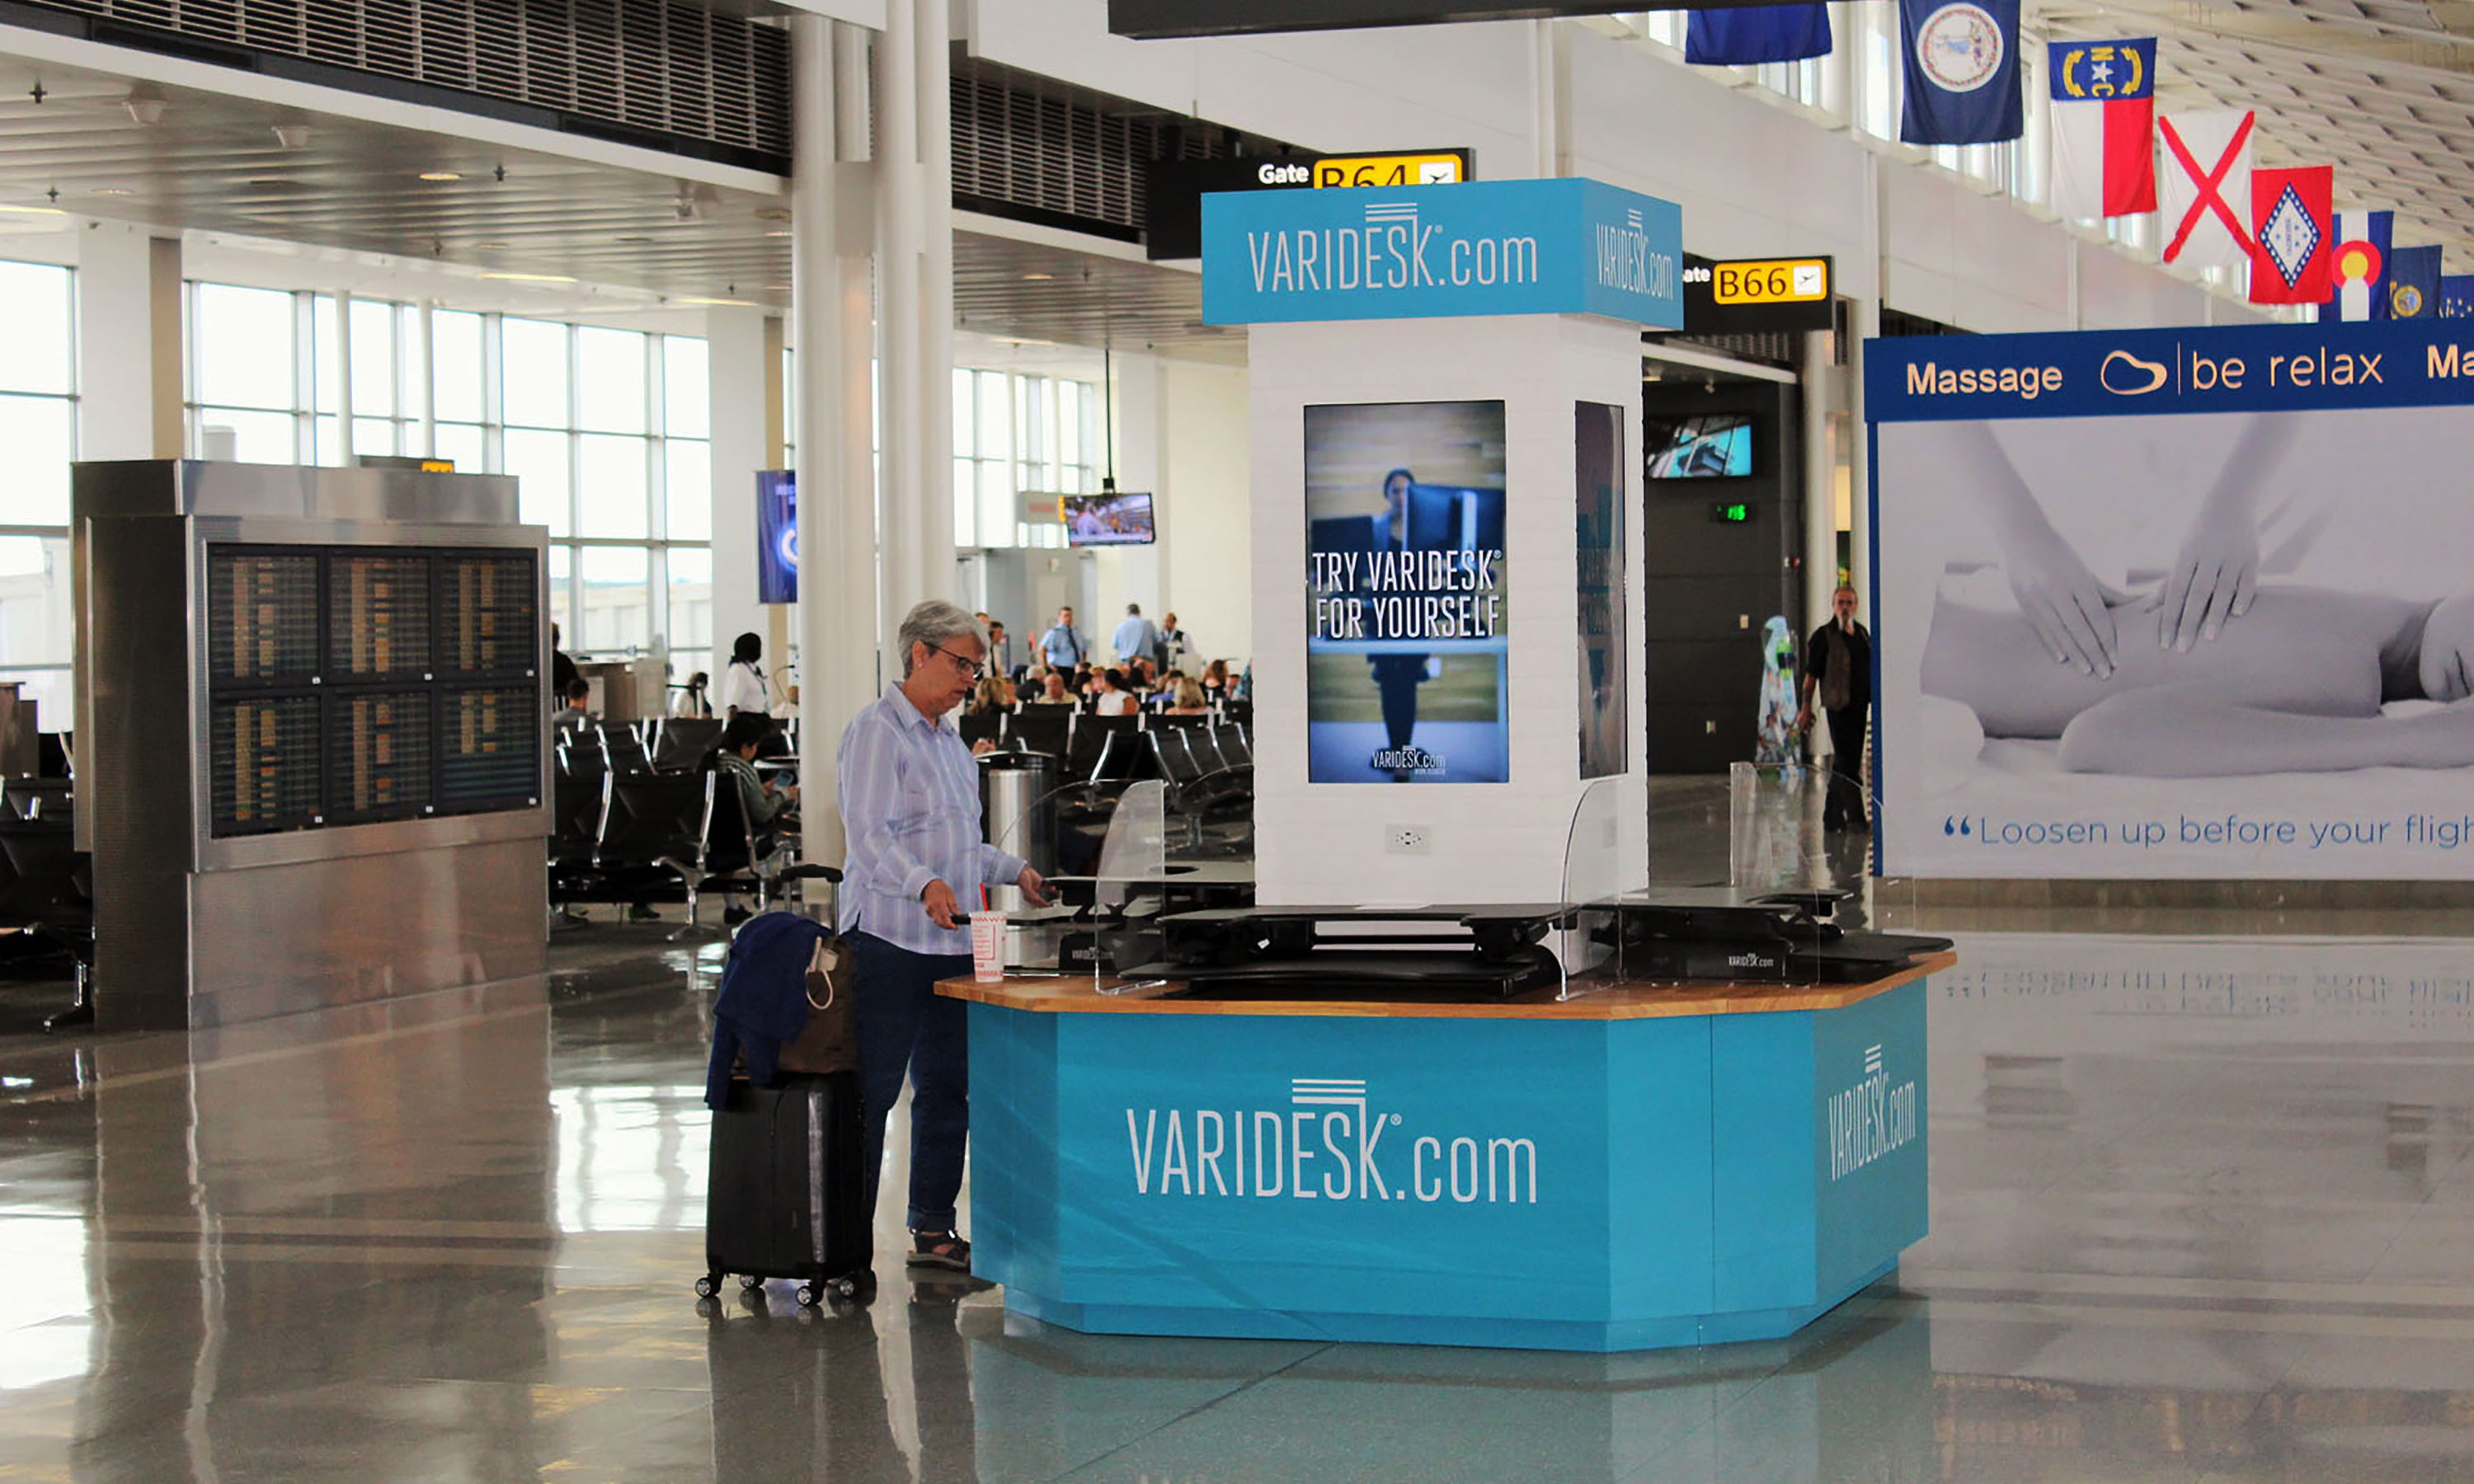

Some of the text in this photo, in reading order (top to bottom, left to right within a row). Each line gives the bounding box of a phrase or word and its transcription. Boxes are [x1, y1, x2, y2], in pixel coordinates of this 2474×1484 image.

[1258, 163, 1309, 185] Gate
[1682, 266, 1787, 298] ate B66
[1907, 362, 2062, 400] Massage
[2193, 346, 2383, 390] be relax
[1312, 552, 1359, 592] TRY
[1315, 594, 1501, 639] FOR YOURSELF
[2122, 824, 2166, 848] up
[2180, 815, 2297, 845] before
[2309, 821, 2391, 850] your
